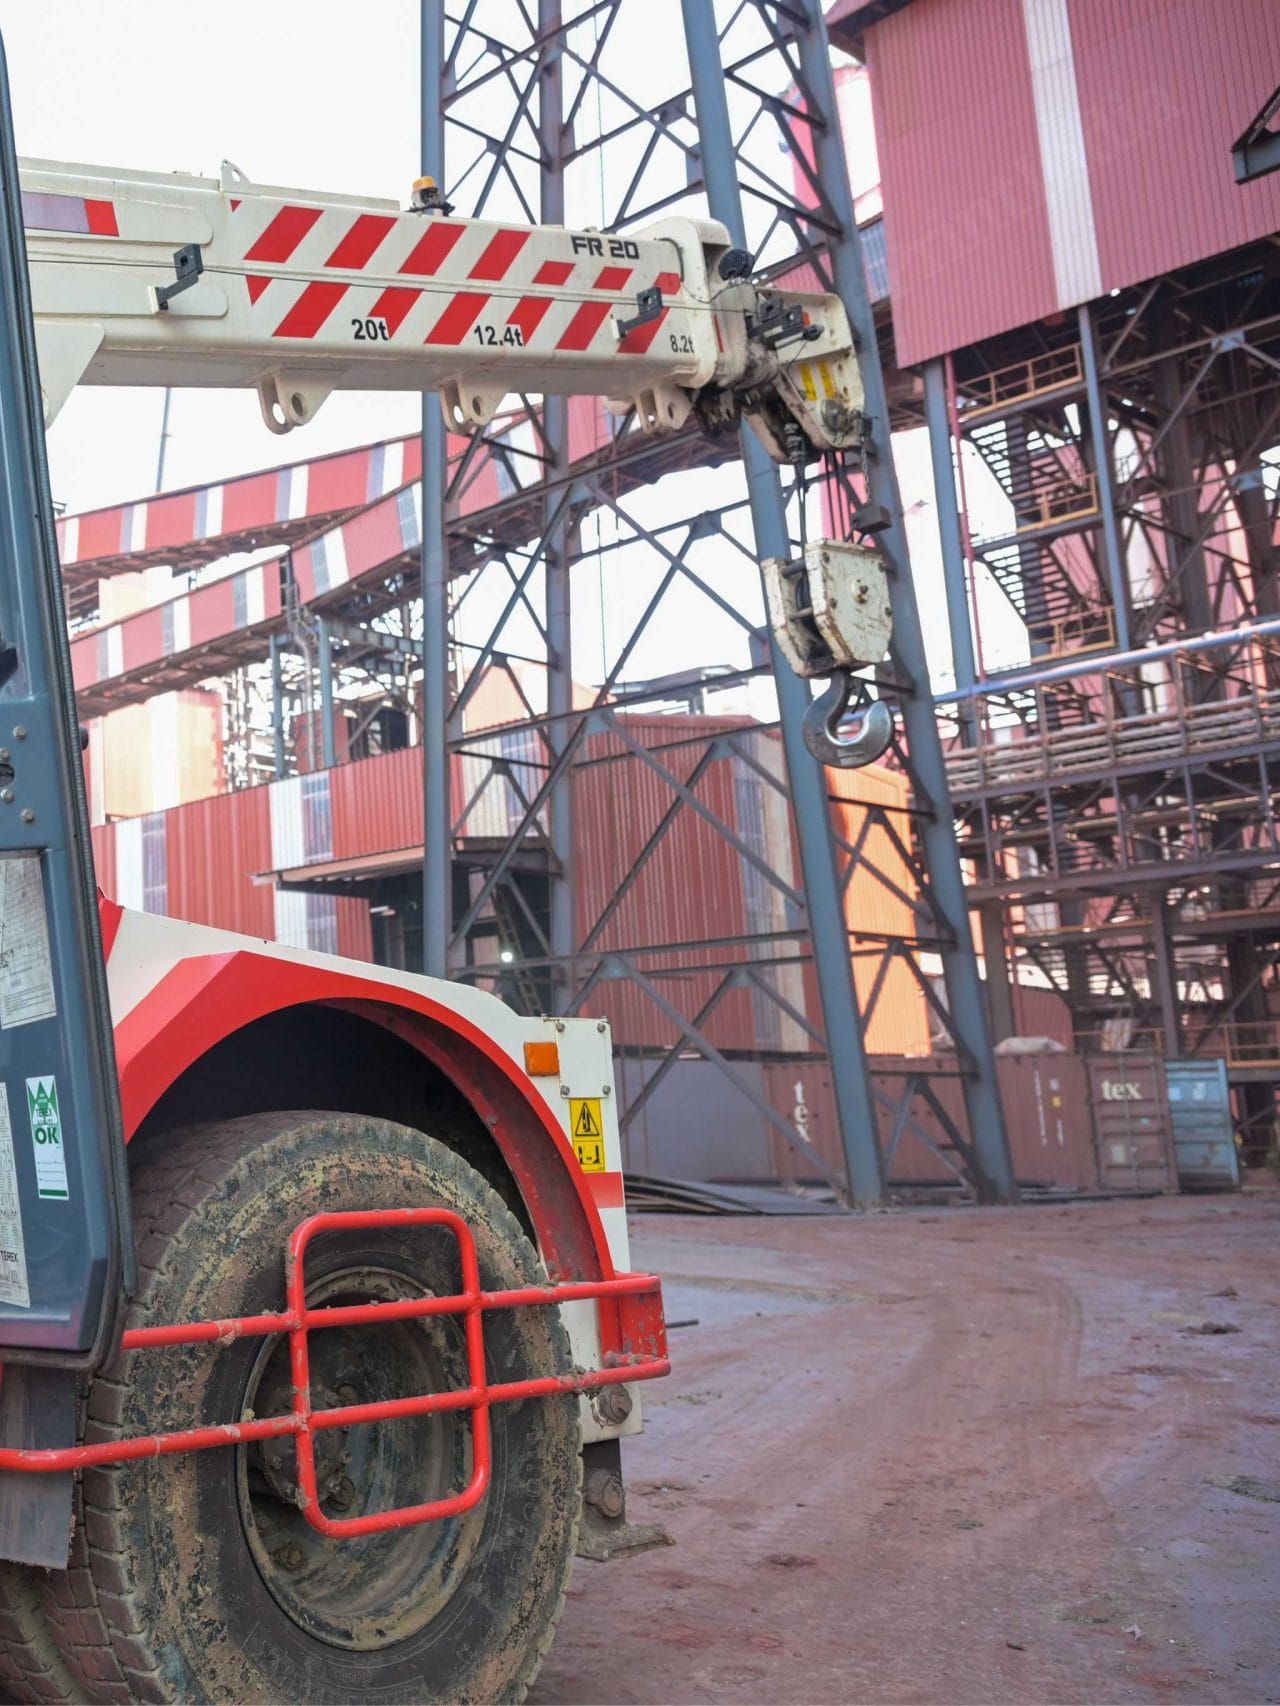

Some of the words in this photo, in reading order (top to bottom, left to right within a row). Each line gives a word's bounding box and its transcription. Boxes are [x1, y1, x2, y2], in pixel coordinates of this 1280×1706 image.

[571, 235, 604, 258] FR
[607, 239, 640, 260] 20
[351, 318, 388, 342] 20t
[474, 324, 524, 347] 12.4t
[669, 334, 695, 354] 8.2t
[1101, 1079, 1142, 1100] tex
[793, 1080, 811, 1143] tex
[34, 1126, 59, 1145] OK
[0, 1250, 19, 1263] TEREX
